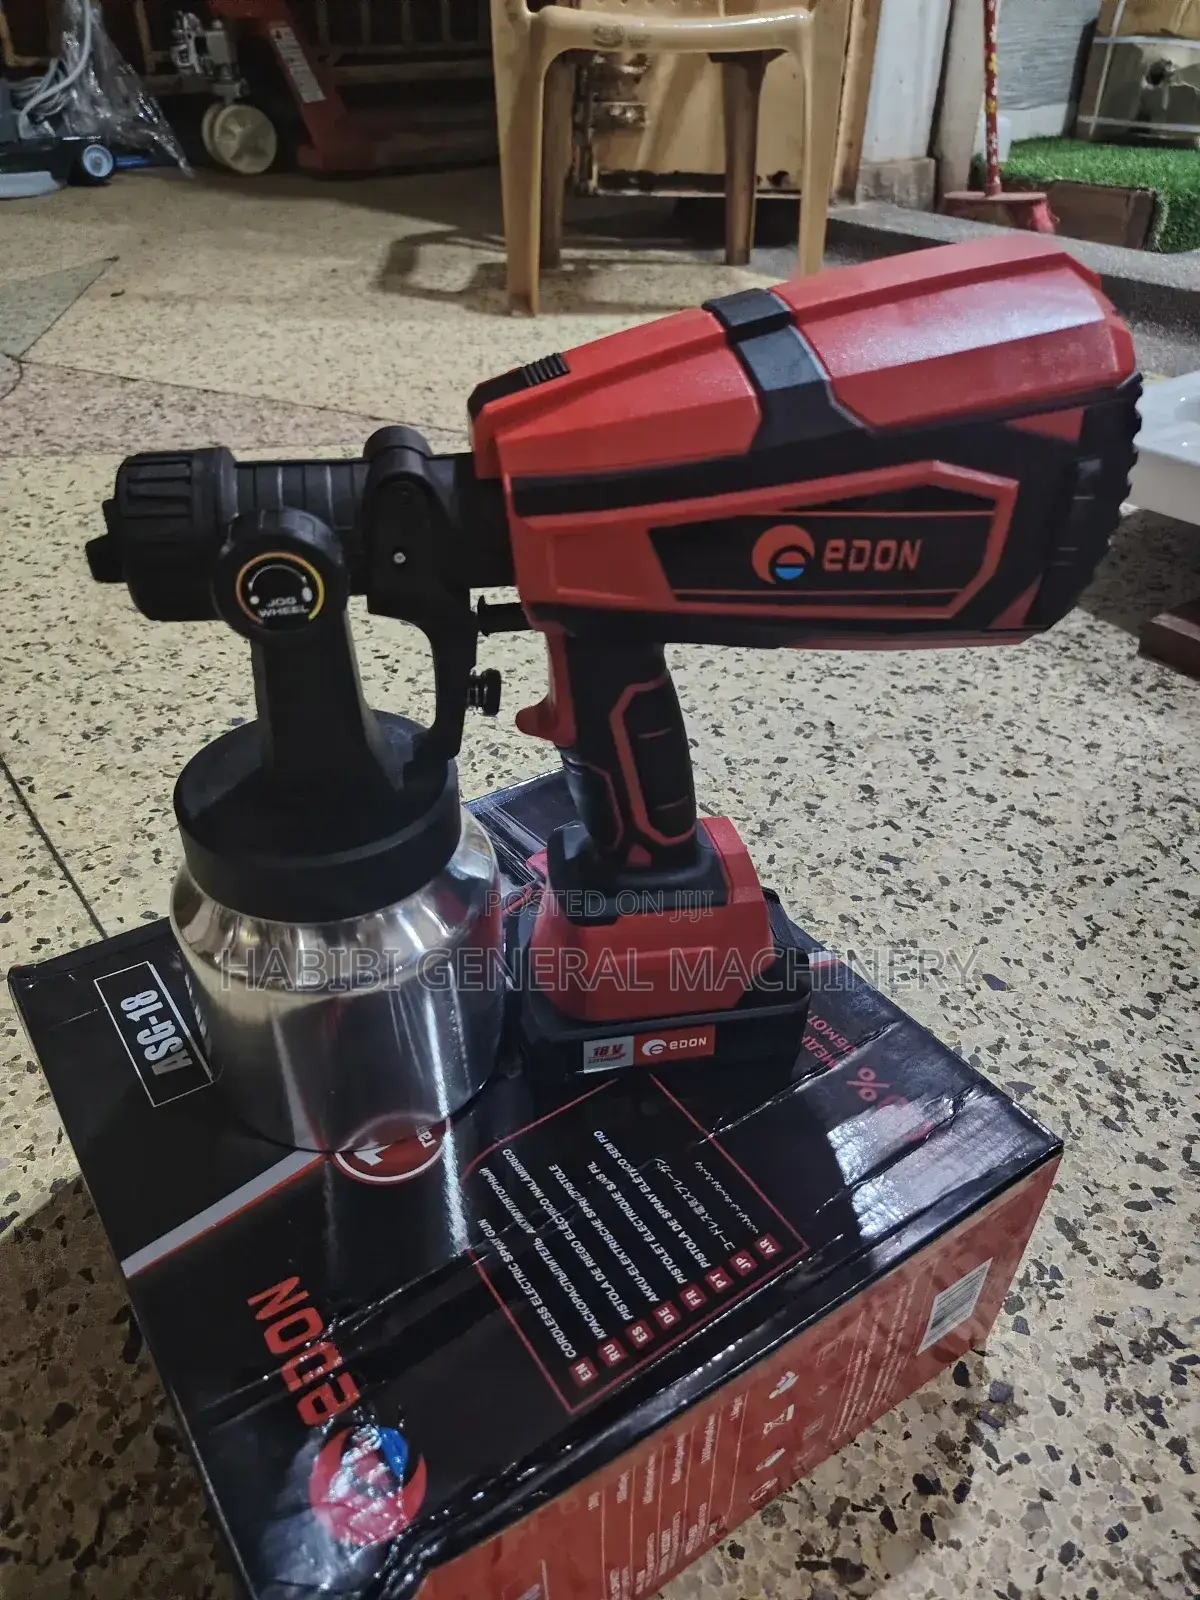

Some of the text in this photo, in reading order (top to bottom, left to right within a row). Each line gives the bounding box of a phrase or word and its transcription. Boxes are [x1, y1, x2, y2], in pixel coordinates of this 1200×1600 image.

[120, 989, 193, 1076] ASG-18
[807, 1011, 857, 1054] ОБМОТ
[592, 1129, 609, 1144] FIO
[602, 1141, 622, 1159] SEM
[586, 1160, 601, 1174] FIL
[610, 1190, 656, 1242] ÉLECTRIQUE
[644, 1192, 672, 1219] SPRAY
[665, 1217, 683, 1232] DE
[547, 1163, 675, 1324] DE AKKU-ELEKTRISCHE SPRIZPISTOLE
[569, 1239, 597, 1268] RIEGO
[677, 1230, 711, 1268] PISTOLA
[758, 1237, 776, 1254] AR
[589, 1266, 606, 1282] DE
[649, 1242, 688, 1284] PISTOLET
[734, 1256, 752, 1269] JP
[533, 1237, 606, 1339] КРАСКОРАСПЫЛИТЕЛЬ
[708, 1272, 727, 1289] PT
[476, 1217, 592, 1381] EN CORDLESS ELECTRIC SPRAY GUN
[599, 1279, 634, 1321] PISTOLA
[684, 1288, 702, 1306] FR
[630, 1325, 648, 1343] ES
[602, 1342, 621, 1362] RU
